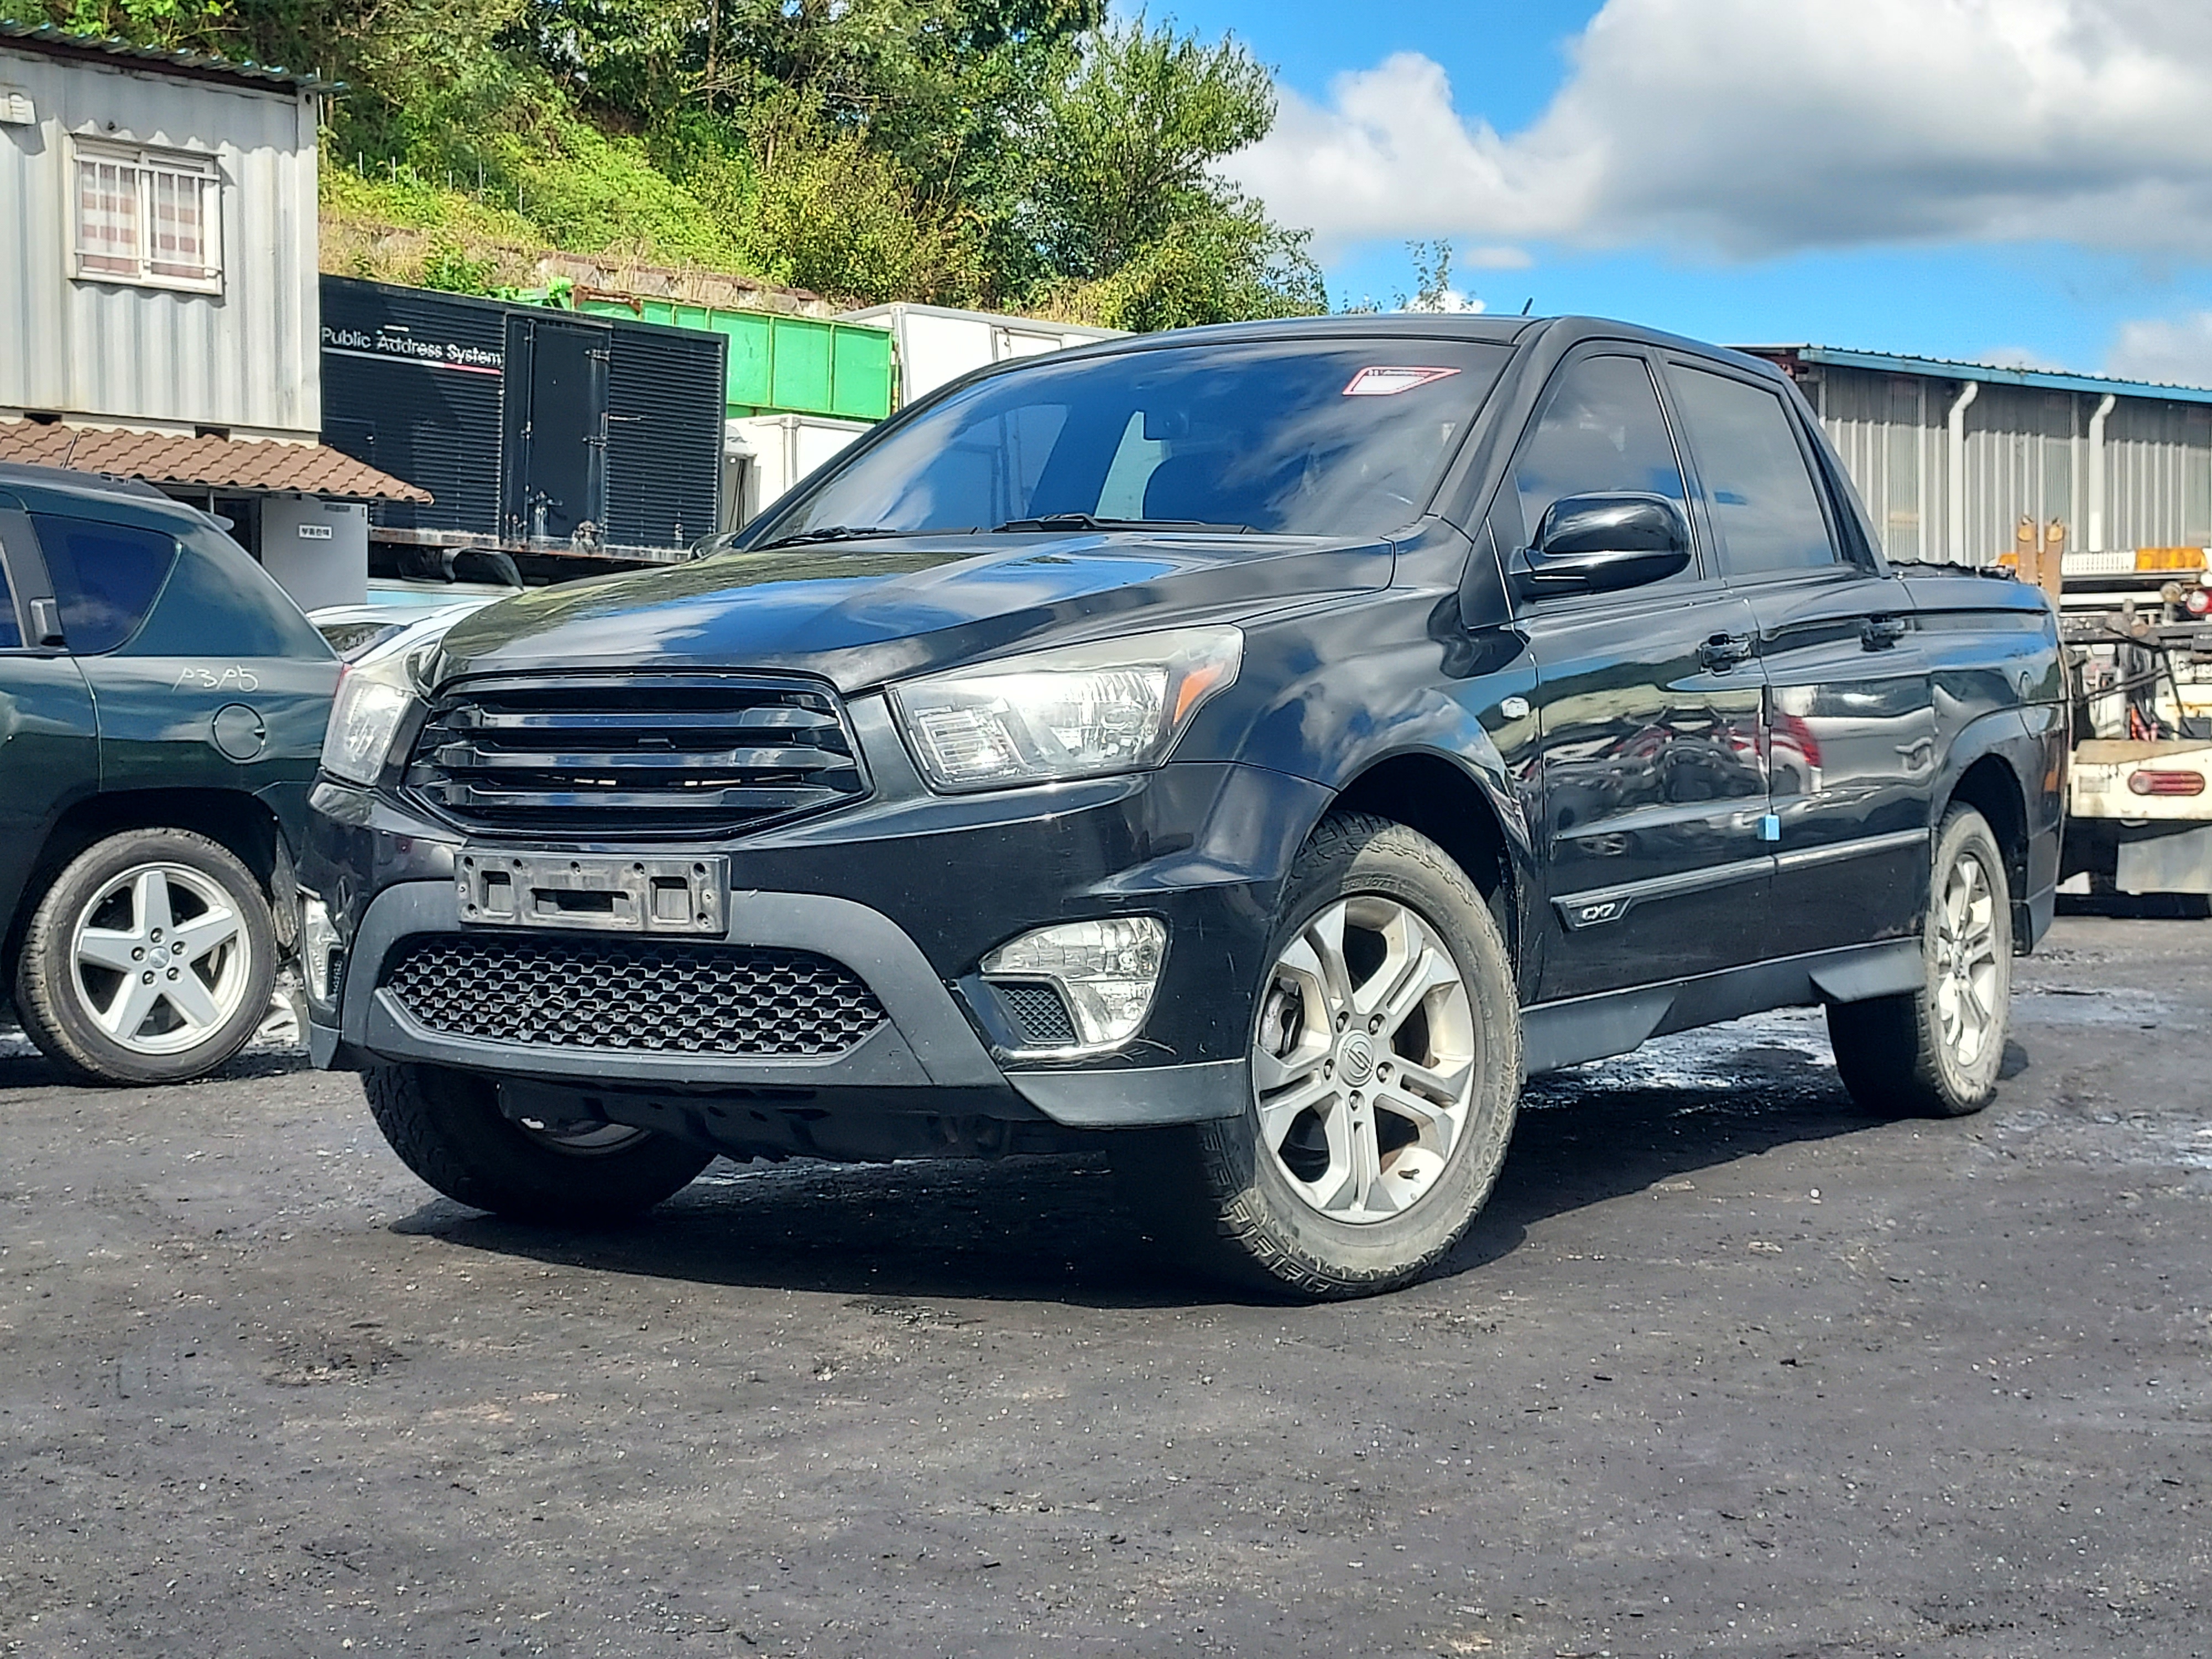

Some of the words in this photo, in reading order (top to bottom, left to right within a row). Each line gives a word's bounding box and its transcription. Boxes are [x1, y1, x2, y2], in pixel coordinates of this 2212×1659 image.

[321, 326, 372, 348] Public
[377, 336, 443, 358] Address
[446, 343, 503, 366] System
[1582, 902, 1616, 921] CX7
